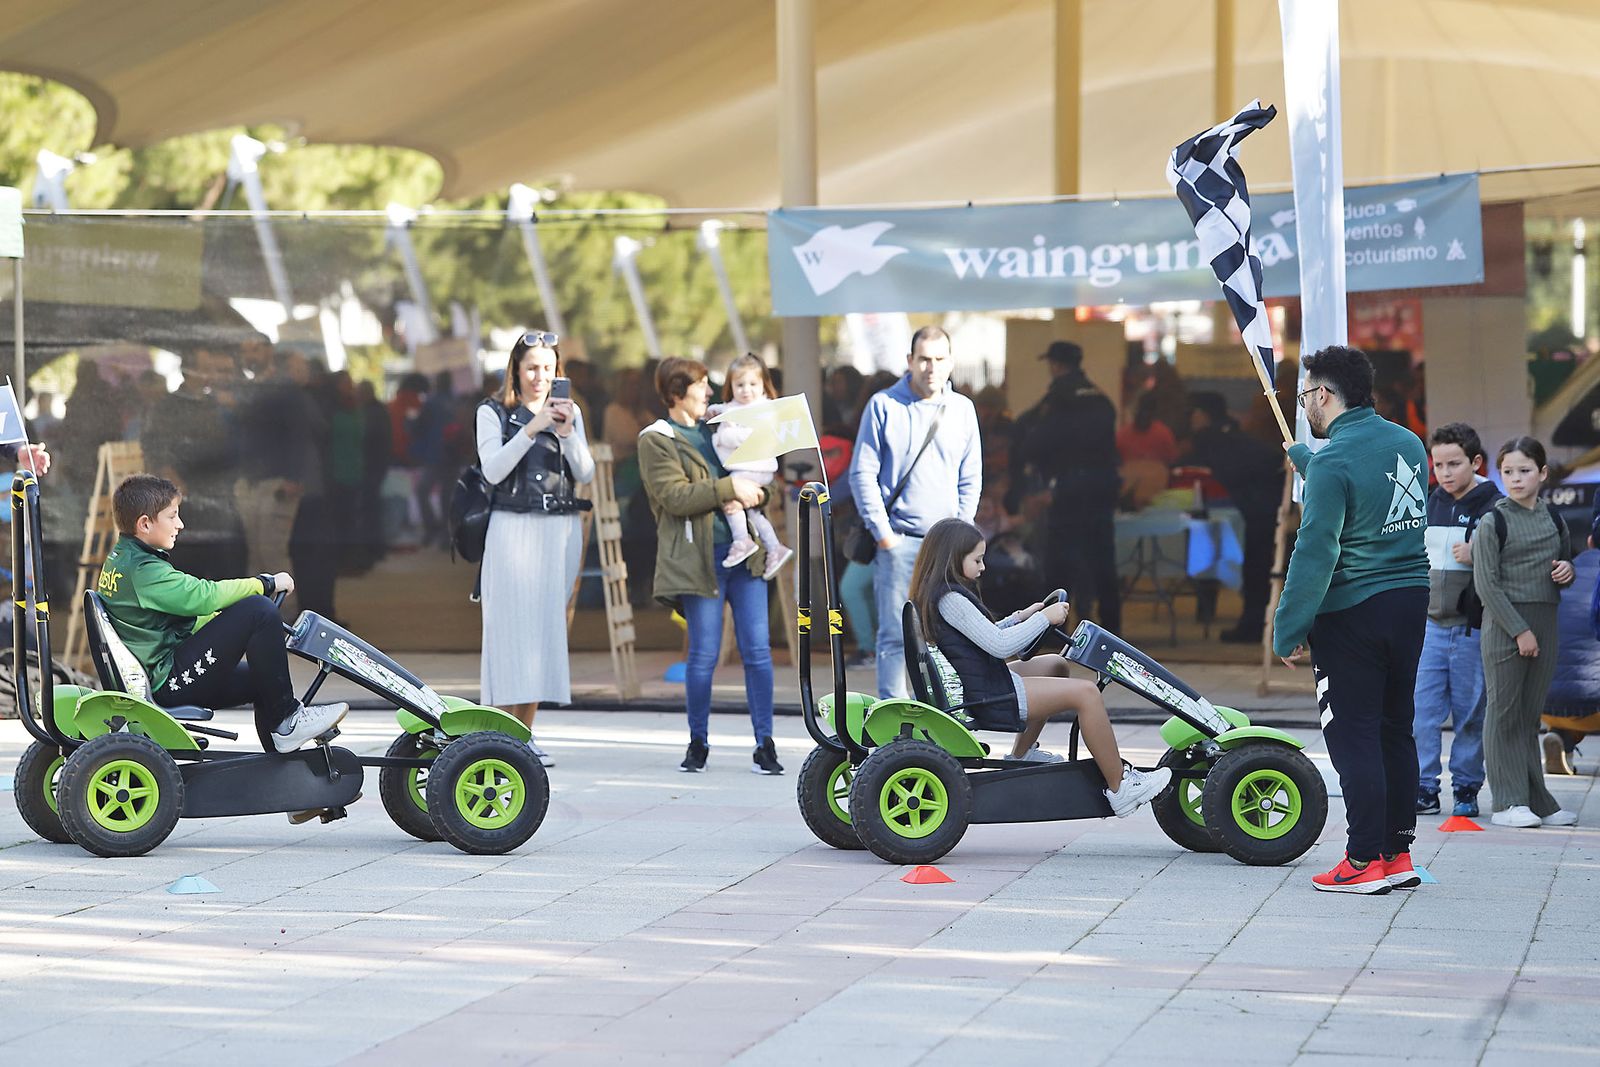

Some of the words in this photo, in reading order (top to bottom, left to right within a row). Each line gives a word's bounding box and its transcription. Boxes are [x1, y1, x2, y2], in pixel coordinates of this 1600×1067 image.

[1344, 203, 1386, 219] duca
[1345, 223, 1404, 240] ventos
[943, 232, 1294, 288] wainguna
[1345, 245, 1438, 265] coturismo
[1118, 652, 1145, 673] BERG
